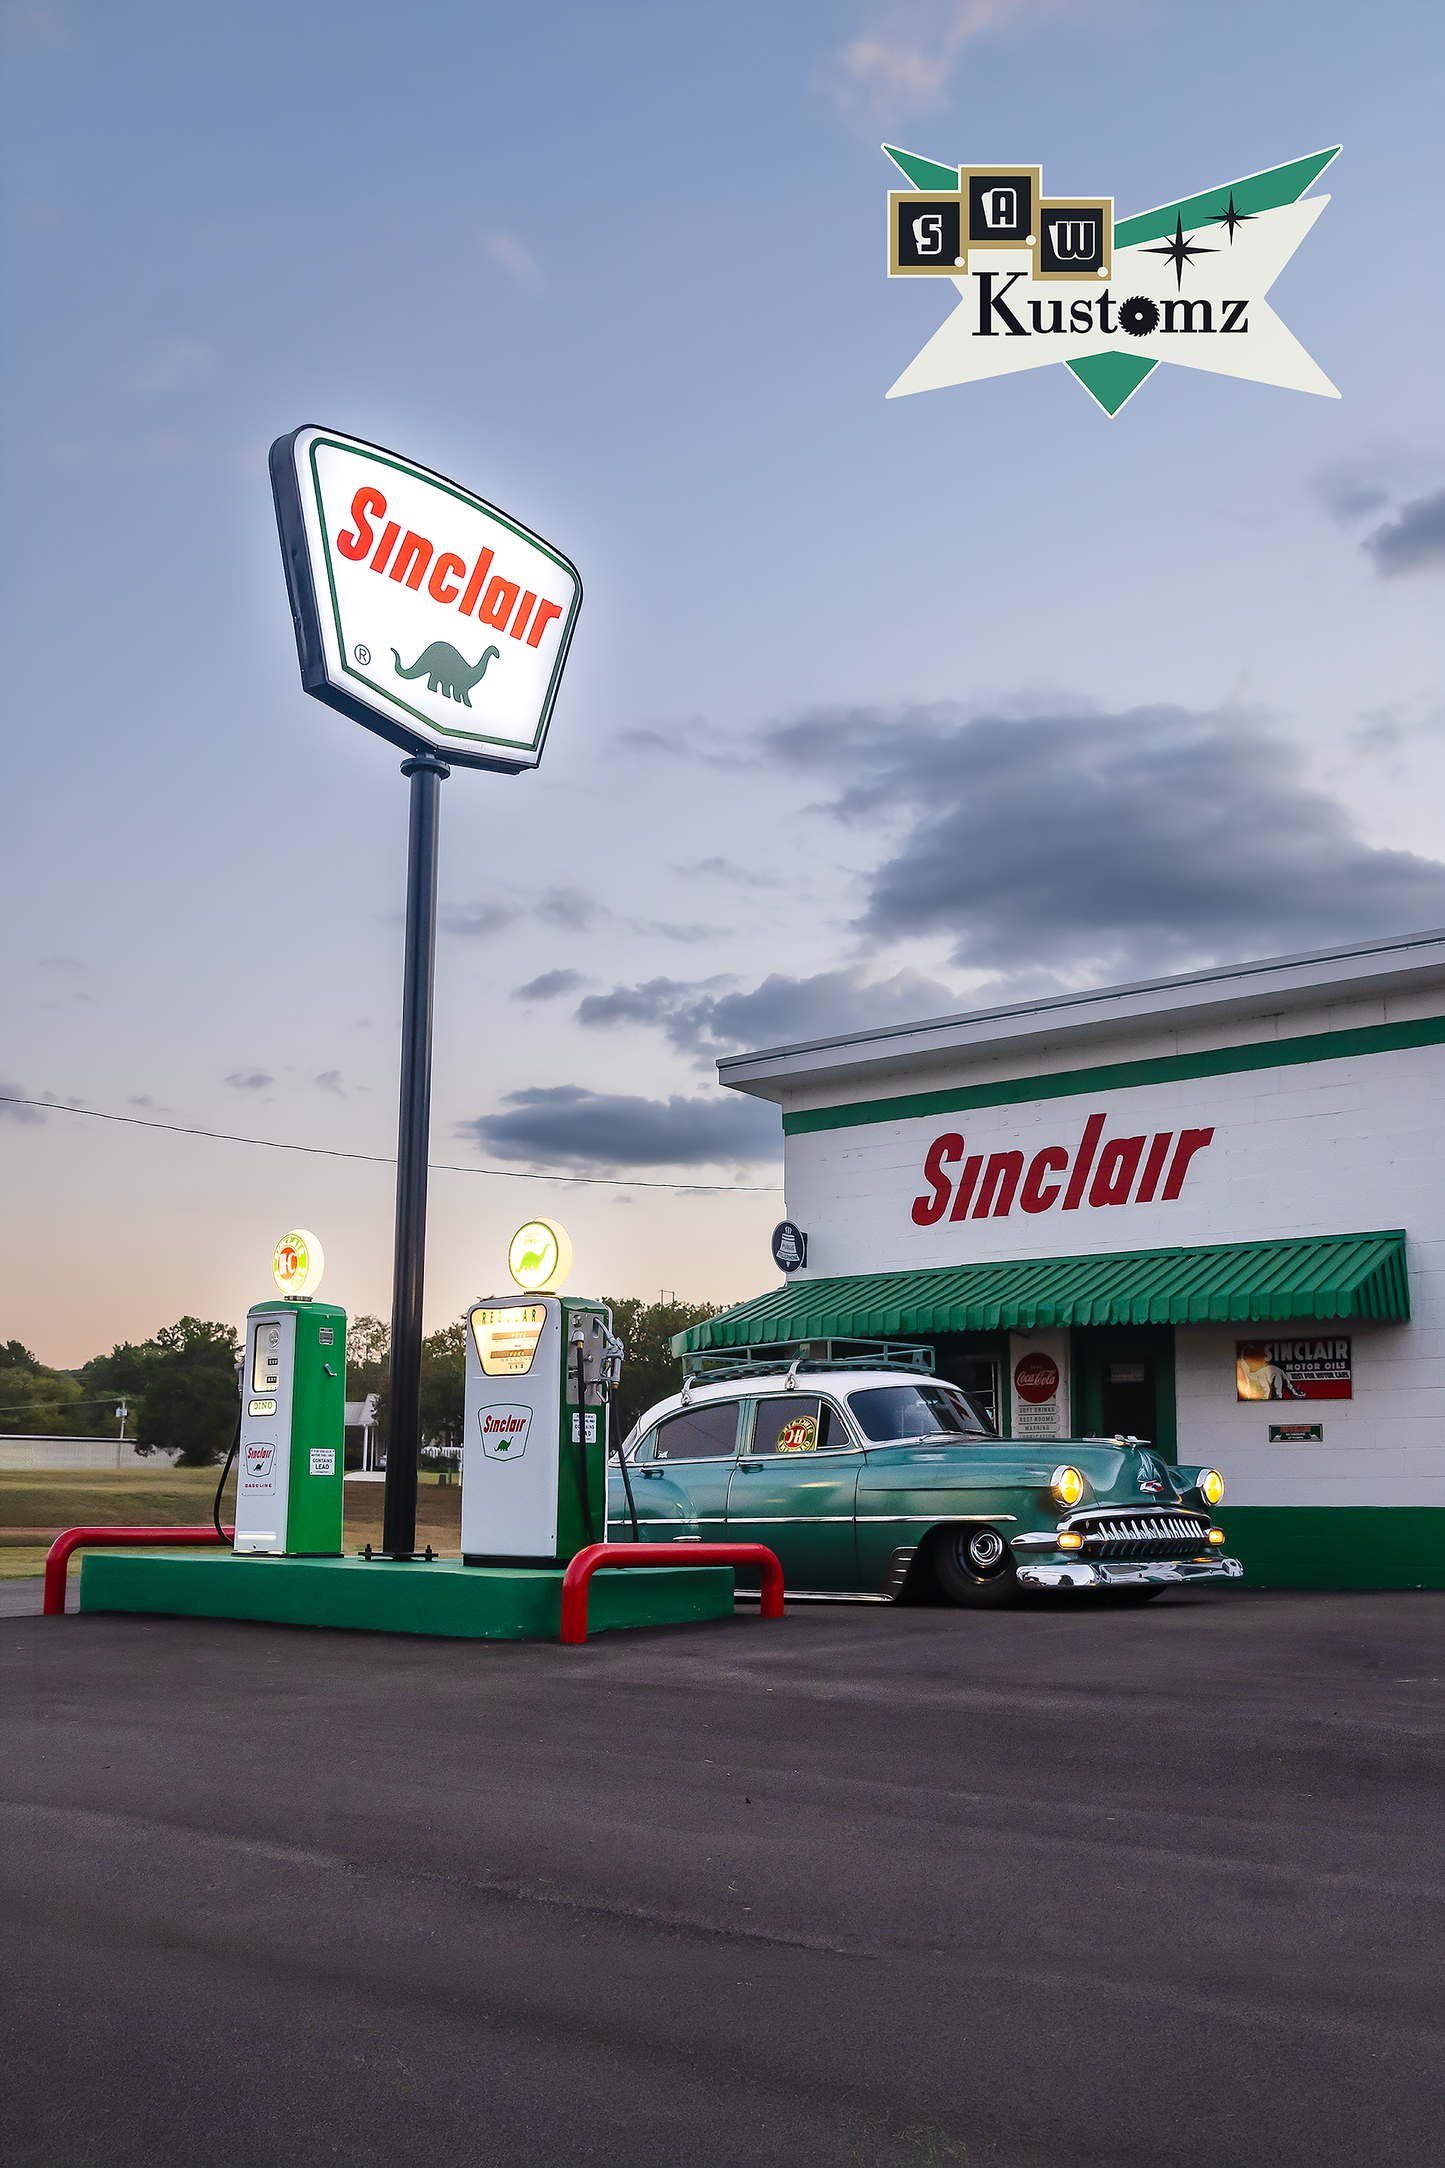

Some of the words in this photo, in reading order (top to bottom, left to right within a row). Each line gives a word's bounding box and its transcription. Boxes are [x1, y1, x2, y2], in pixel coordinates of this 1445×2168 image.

[337, 486, 563, 648] Sinclair
[911, 1112, 1216, 1226] Sinclair
[1264, 1340, 1349, 1362] SINCLAIR
[1286, 1362, 1321, 1371] MOTOR
[1324, 1361, 1346, 1370] OILS
[253, 1401, 273, 1410] DINO
[483, 1414, 527, 1433] Sinclair
[247, 1447, 272, 1459] Sinclair
